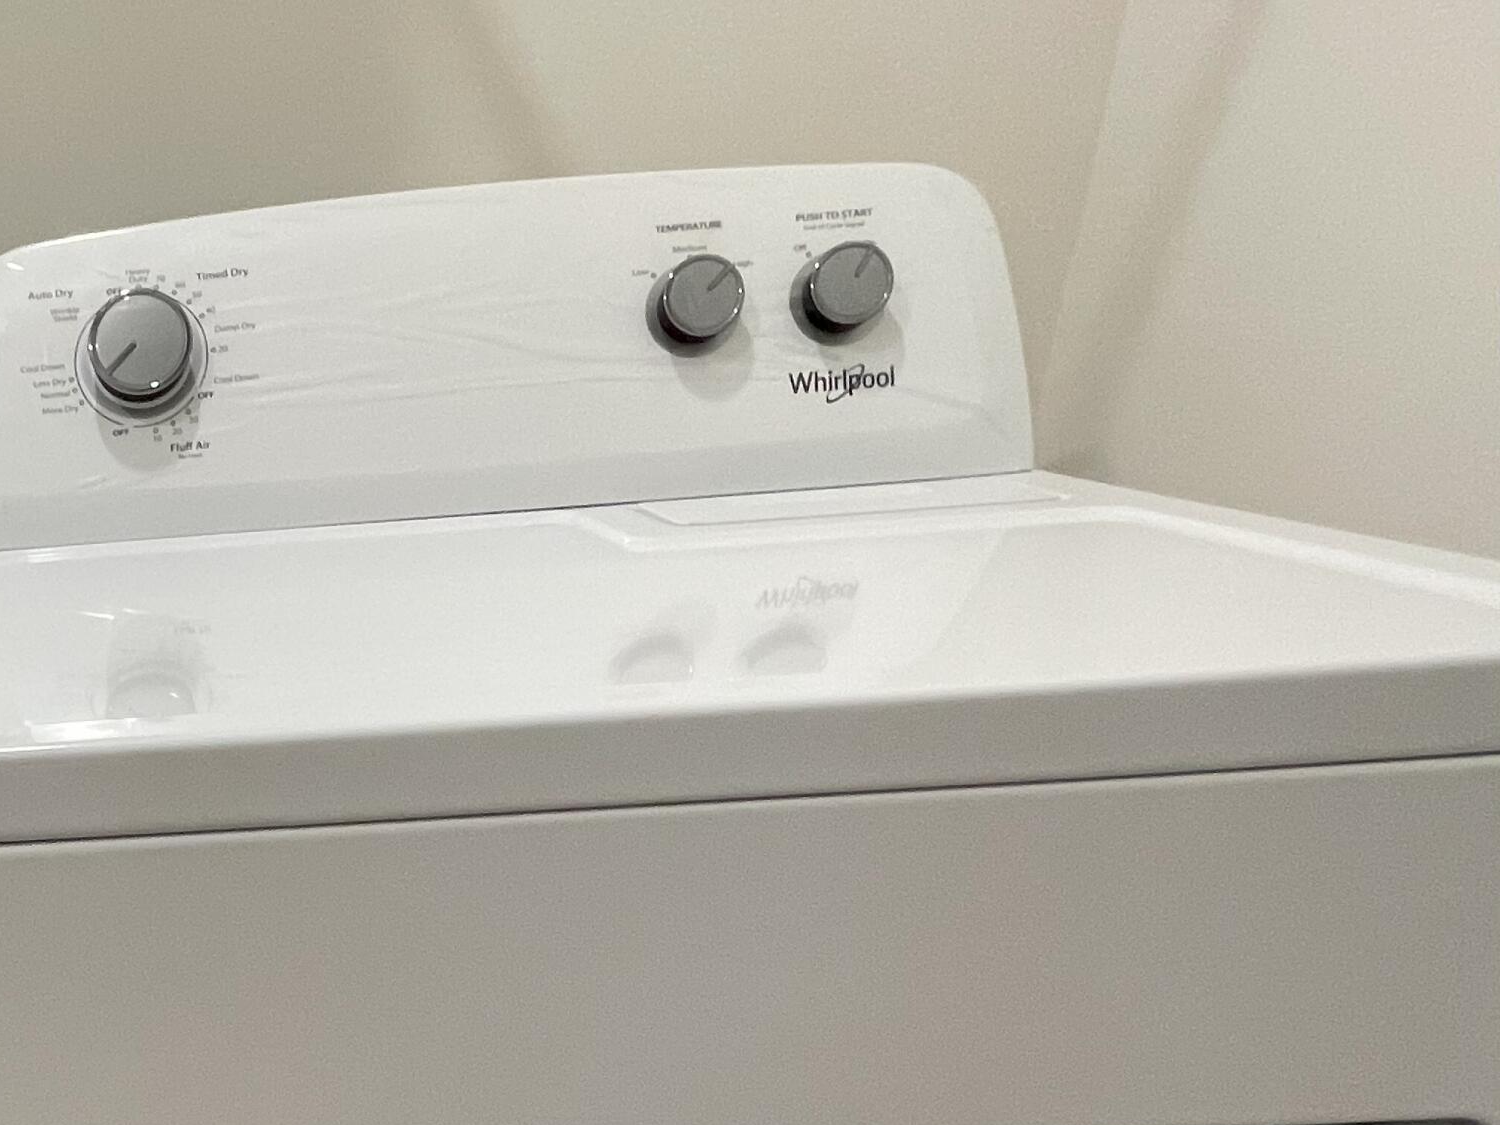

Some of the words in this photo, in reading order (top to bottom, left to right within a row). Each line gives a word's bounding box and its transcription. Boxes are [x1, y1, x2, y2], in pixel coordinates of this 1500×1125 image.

[796, 212, 823, 221] PUSH
[825, 210, 840, 220] TO
[841, 207, 873, 219] START
[655, 220, 722, 233] TEMPERATURE
[196, 269, 228, 281] Timed
[230, 267, 249, 277] Dry
[28, 290, 54, 301] Auto
[55, 288, 74, 299] Dry
[789, 363, 896, 404] Whirlpool
[198, 391, 214, 400] OFF
[112, 428, 130, 437] OFF
[170, 440, 193, 452] Fluff
[195, 440, 210, 451] Air
